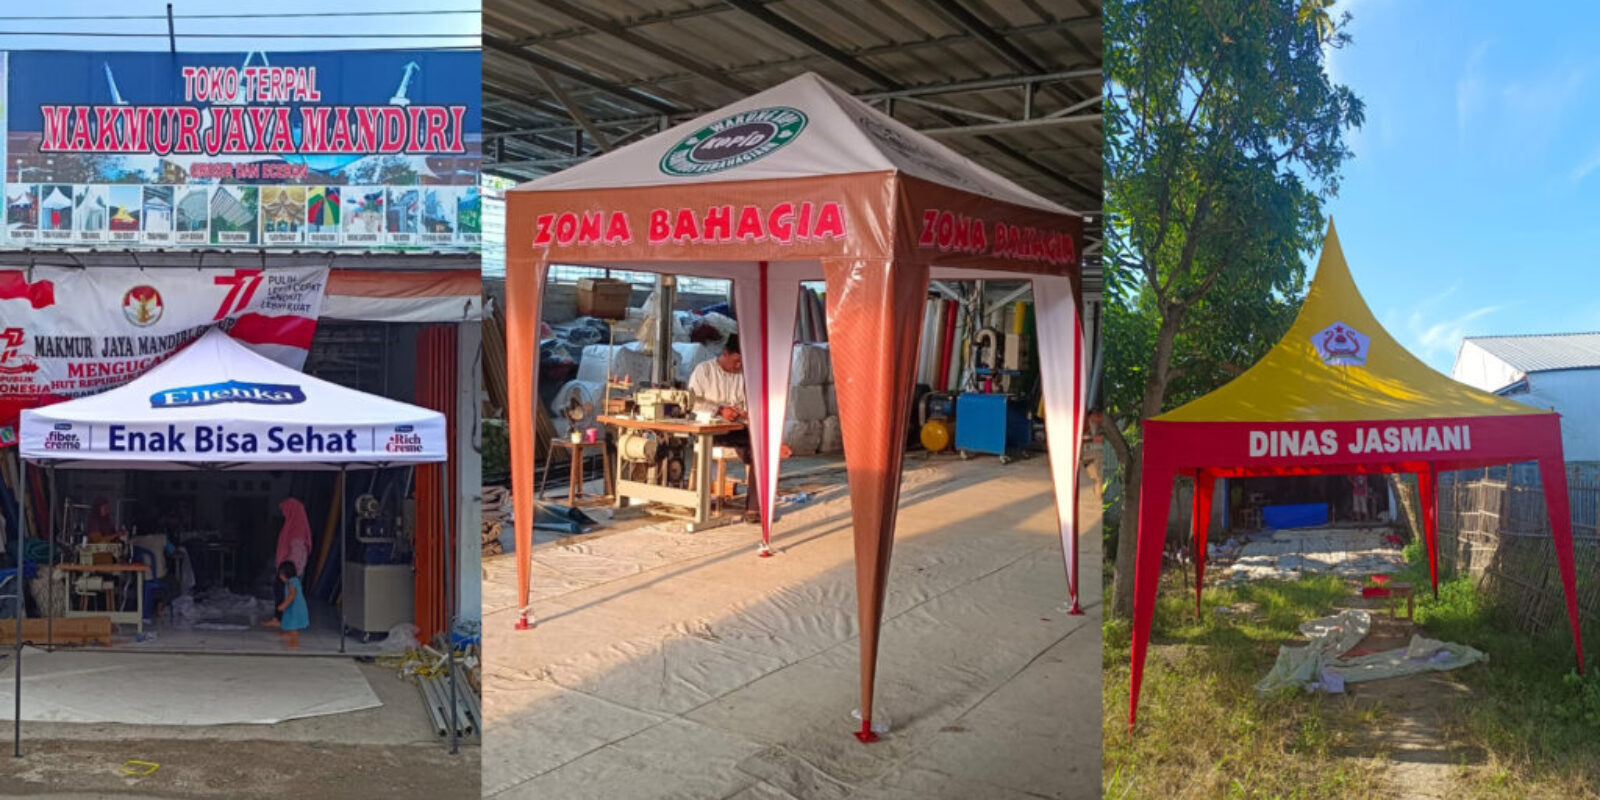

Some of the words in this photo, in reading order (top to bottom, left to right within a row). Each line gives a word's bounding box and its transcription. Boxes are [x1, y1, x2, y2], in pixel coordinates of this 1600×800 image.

[182, 67, 239, 102] TOKO
[245, 67, 321, 102] TERPAL
[40, 105, 201, 154] MAKMUR
[204, 105, 296, 154] JAYA
[299, 105, 468, 153] MANDIRI
[236, 163, 259, 178] DAN
[533, 211, 633, 248] ZONA
[648, 202, 848, 246] BAHAGIA
[919, 208, 987, 252] ZONA
[993, 223, 1075, 263] BAHAGIA
[34, 335, 94, 358] MAKMUR
[102, 335, 134, 358] JAYA
[51, 380, 76, 390] HUT
[109, 424, 186, 453] Enak
[195, 424, 257, 454] Bisa
[267, 425, 357, 454] Sehat
[1249, 429, 1339, 457] DINAS
[1347, 425, 1471, 454] JASMANI
